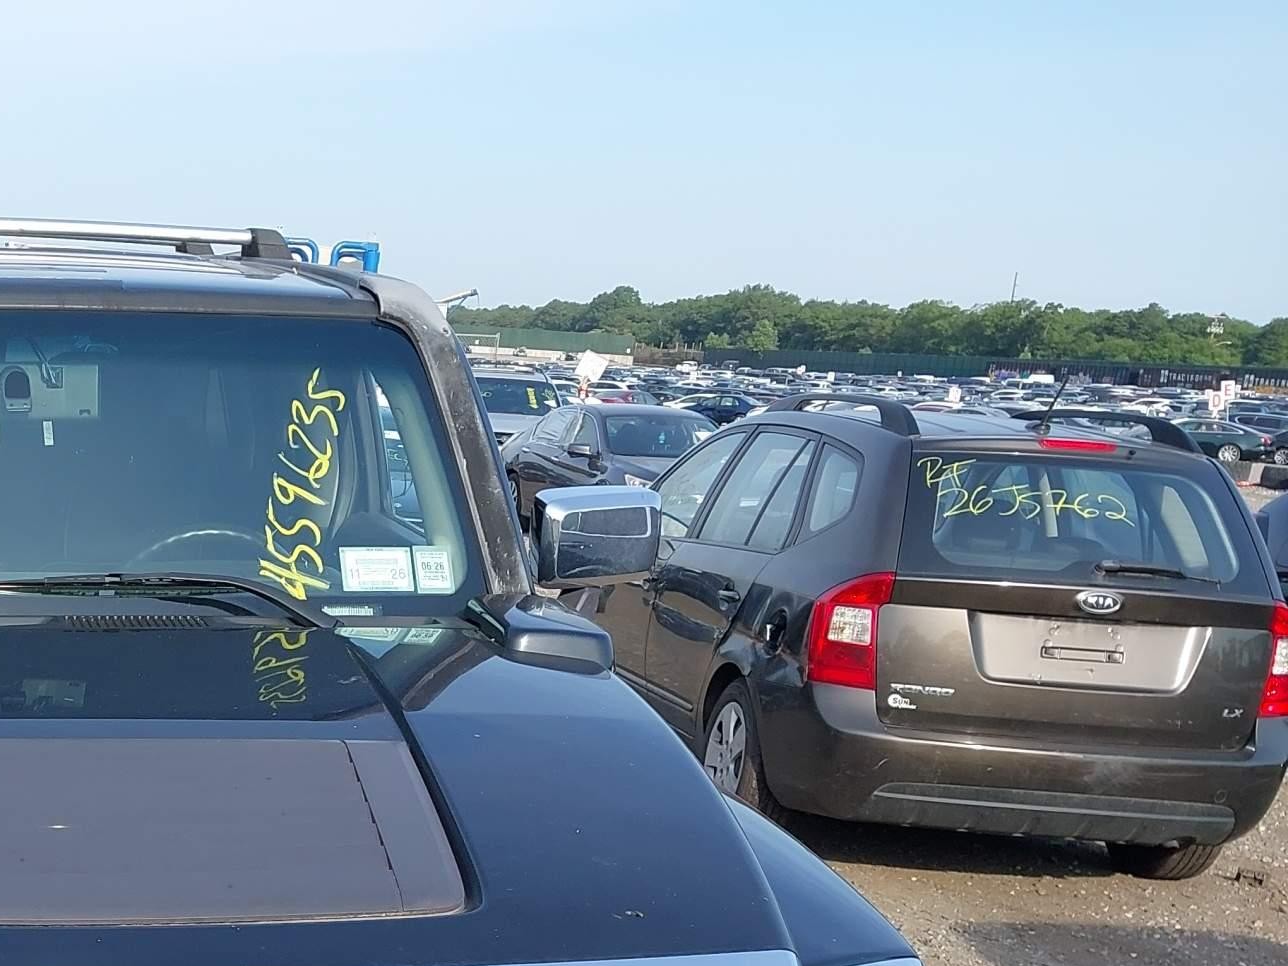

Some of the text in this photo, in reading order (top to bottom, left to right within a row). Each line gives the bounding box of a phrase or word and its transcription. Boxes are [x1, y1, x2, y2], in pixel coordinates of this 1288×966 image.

[1224, 384, 1232, 396] E
[1212, 394, 1221, 408] D
[258, 367, 346, 600] 45596235
[390, 568, 406, 580] 26
[1087, 596, 1114, 609] KIA
[1223, 708, 1244, 718] LX
